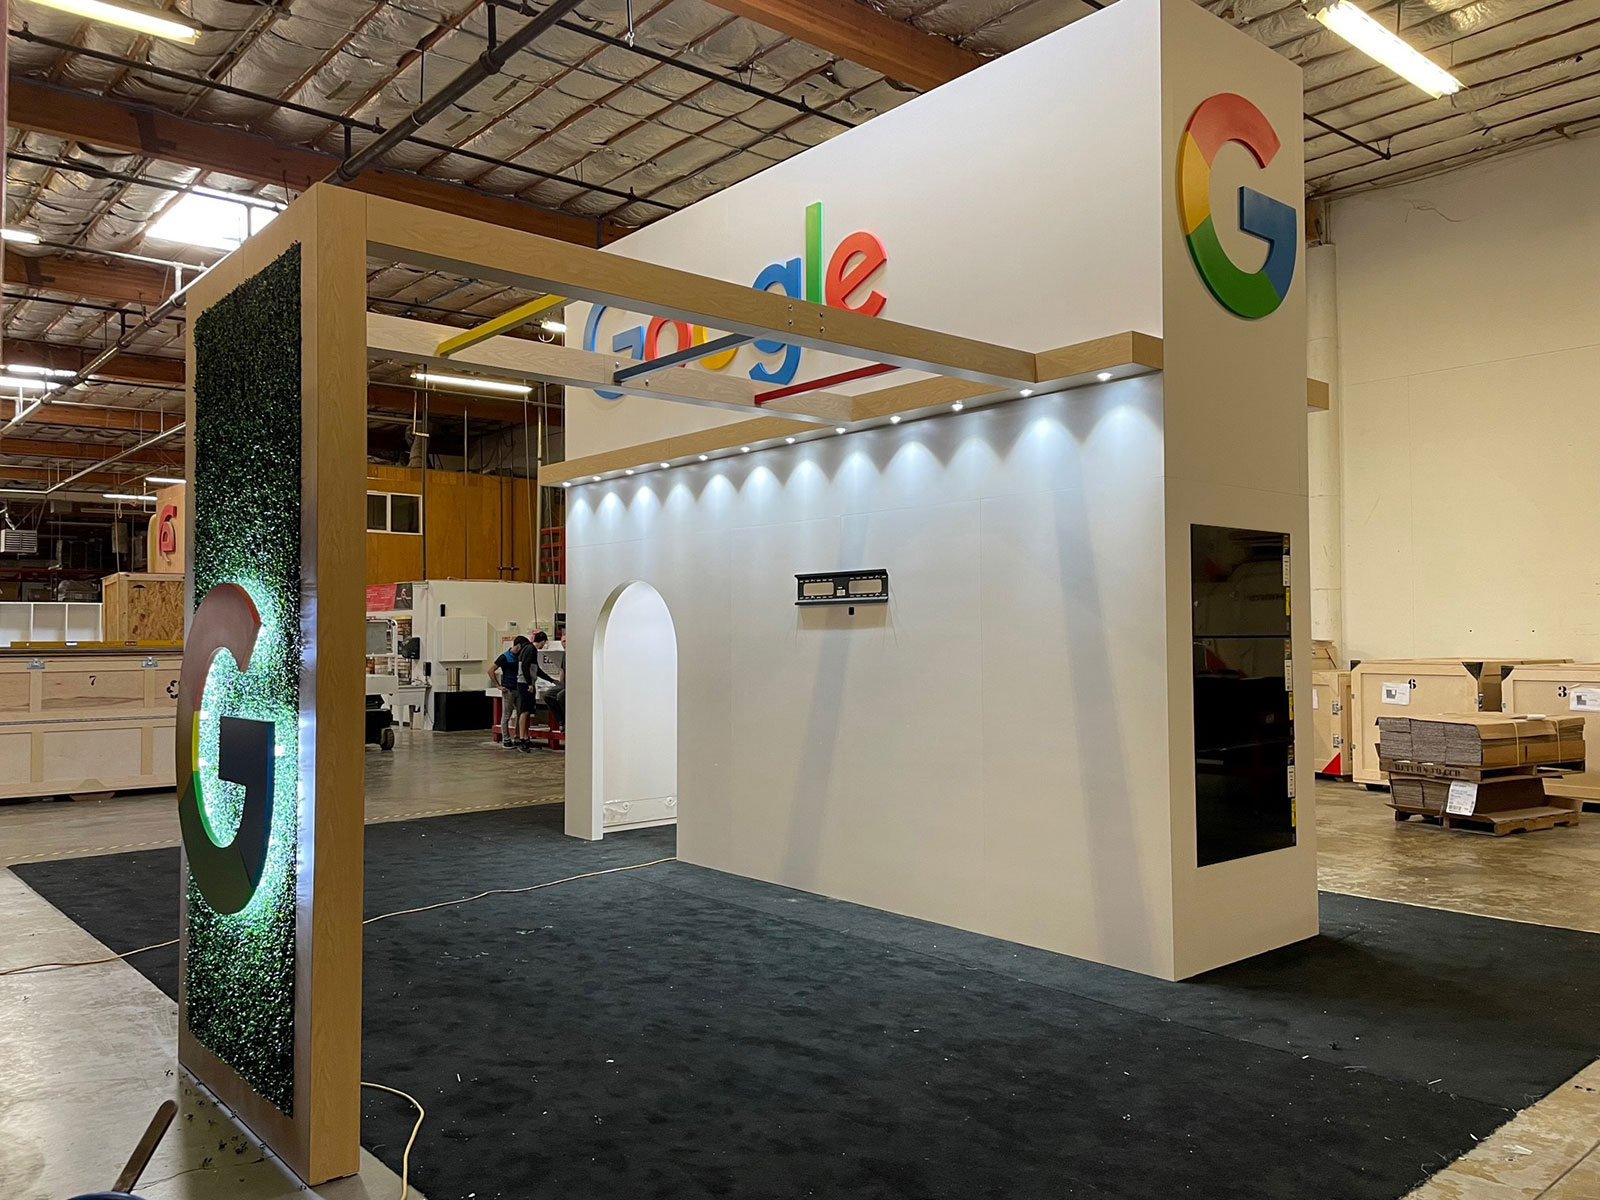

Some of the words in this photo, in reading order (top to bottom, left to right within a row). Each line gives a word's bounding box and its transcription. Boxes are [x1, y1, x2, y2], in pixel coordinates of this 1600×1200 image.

[1177, 92, 1297, 318] G
[88, 675, 97, 686] 7
[1408, 679, 1417, 689] 6
[1557, 686, 1568, 698] 3
[176, 582, 275, 915] G
[1430, 767, 1442, 775] TO
